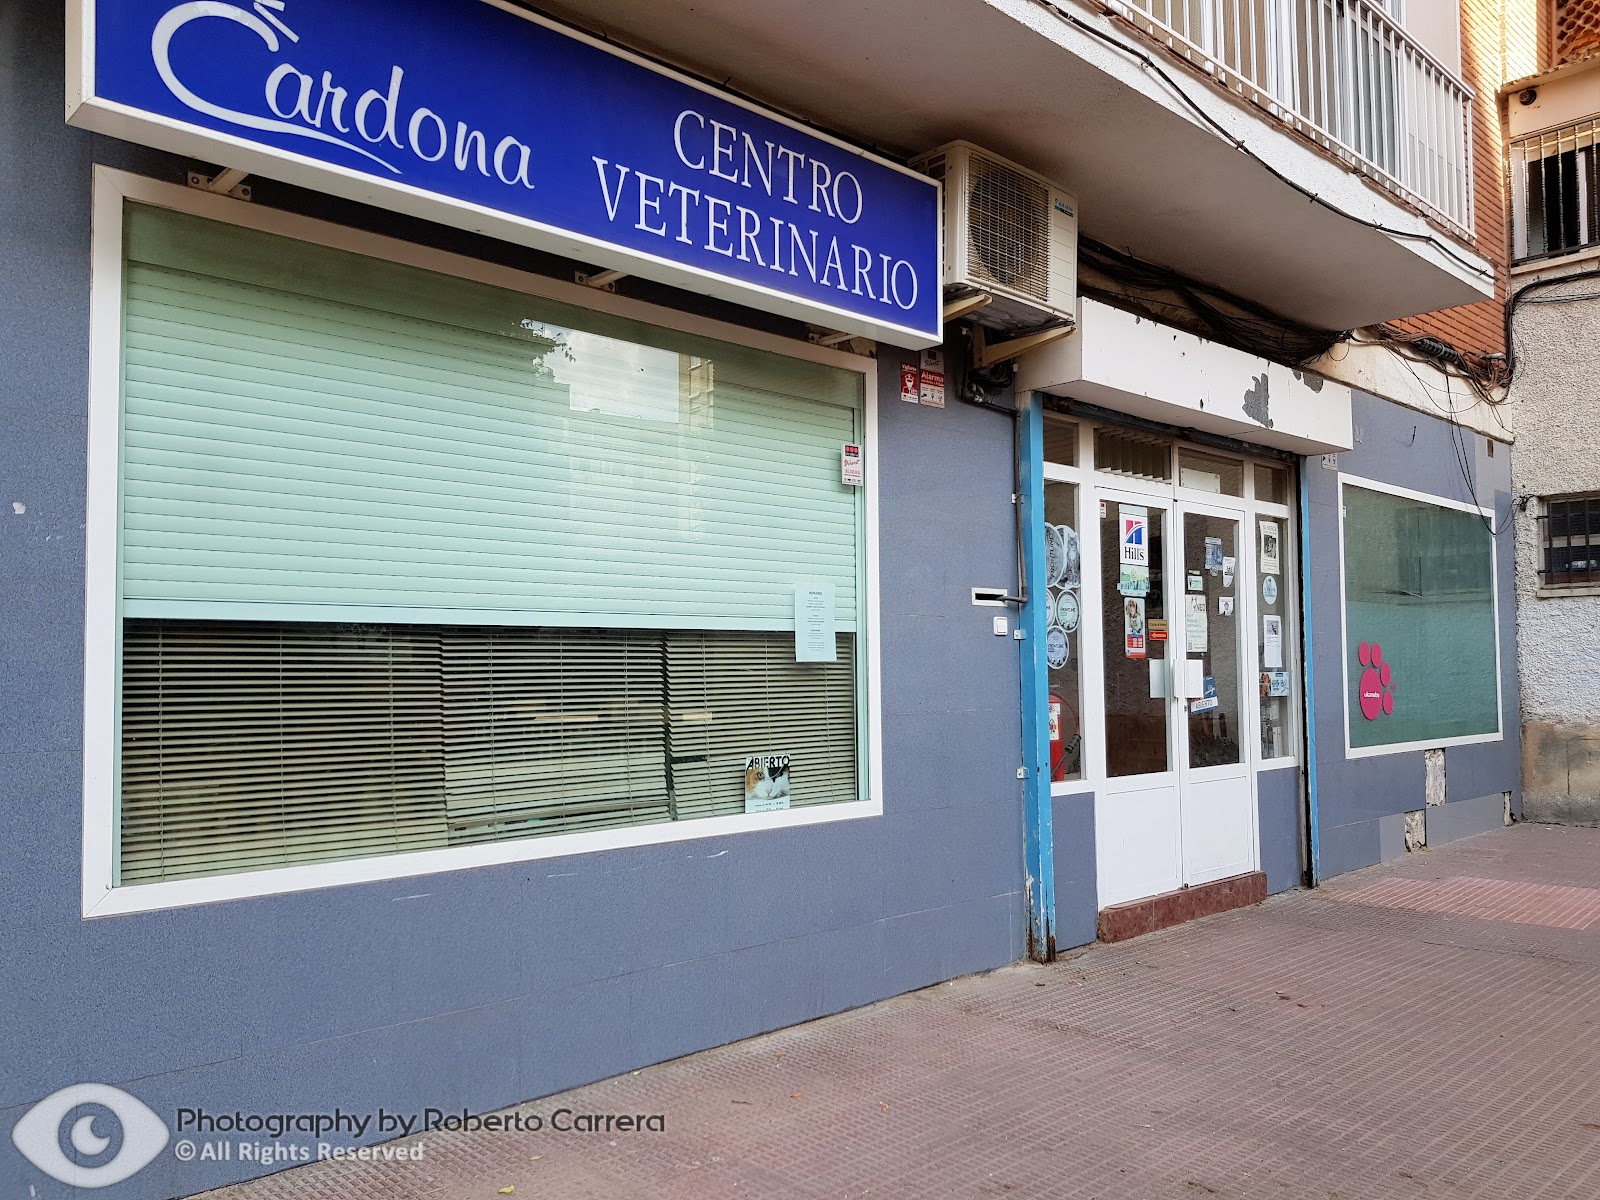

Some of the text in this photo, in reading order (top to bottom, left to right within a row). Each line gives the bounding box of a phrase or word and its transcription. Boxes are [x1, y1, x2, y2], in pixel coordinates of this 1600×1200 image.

[152, 1, 535, 190] Cardona
[673, 109, 864, 225] CENTRO
[592, 156, 918, 310] VETERINARIO
[921, 371, 944, 382] Alarma
[746, 755, 790, 771] ABIERTO
